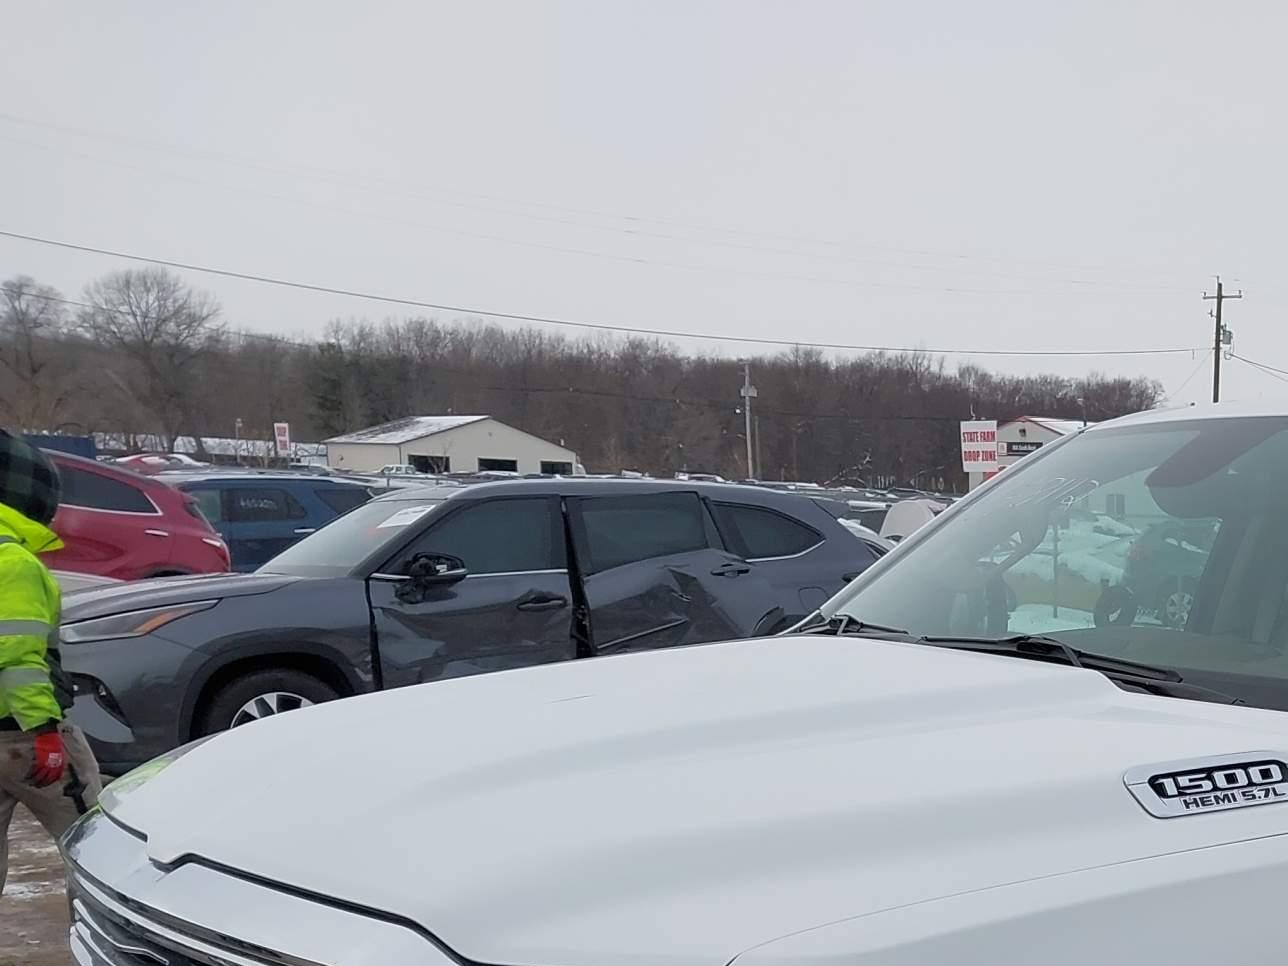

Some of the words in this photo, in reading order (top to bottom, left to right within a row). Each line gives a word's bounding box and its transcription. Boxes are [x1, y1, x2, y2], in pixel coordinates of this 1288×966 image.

[962, 431, 979, 443] STATE
[979, 431, 996, 442] FARM
[963, 450, 980, 462] DROP
[1155, 763, 1283, 796] 1500
[1182, 792, 1240, 810] HEMI
[1241, 787, 1287, 802] 5.7L
